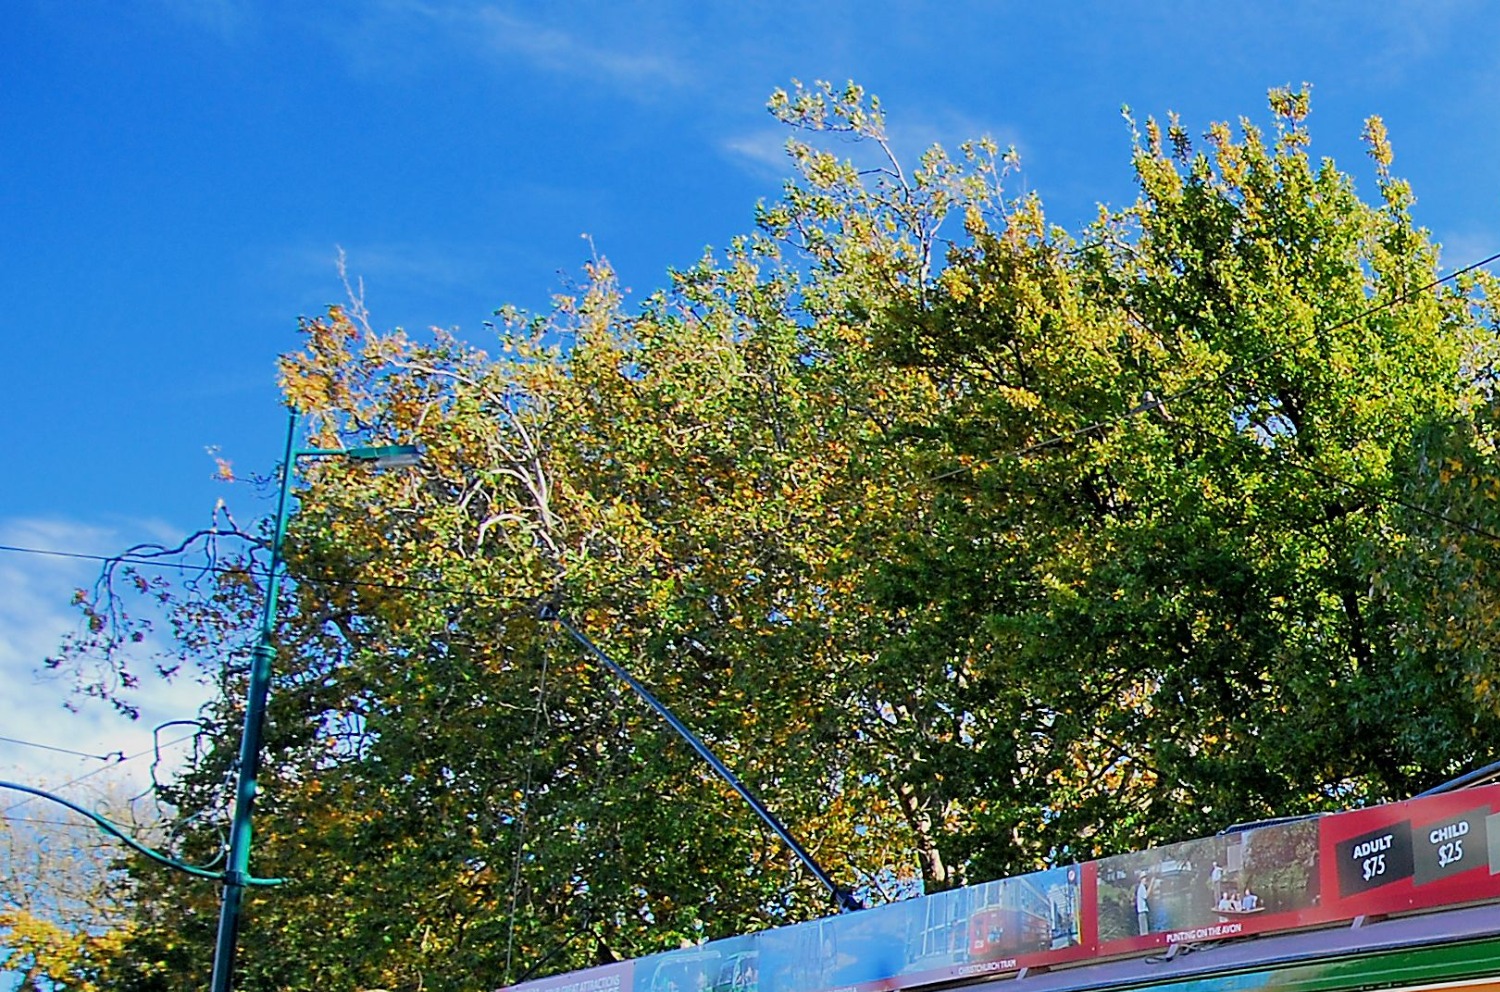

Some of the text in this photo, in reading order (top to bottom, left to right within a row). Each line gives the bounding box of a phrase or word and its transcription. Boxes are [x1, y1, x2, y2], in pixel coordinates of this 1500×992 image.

[1429, 821, 1469, 844] CHILD
[1353, 835, 1393, 859] ADULT
[1438, 840, 1463, 867] $25
[1363, 854, 1386, 881] $75
[1166, 923, 1242, 943] PUNTING ON THE AVON
[1001, 959, 1017, 969] TRAM
[580, 974, 620, 991] ATTRACTIONS
